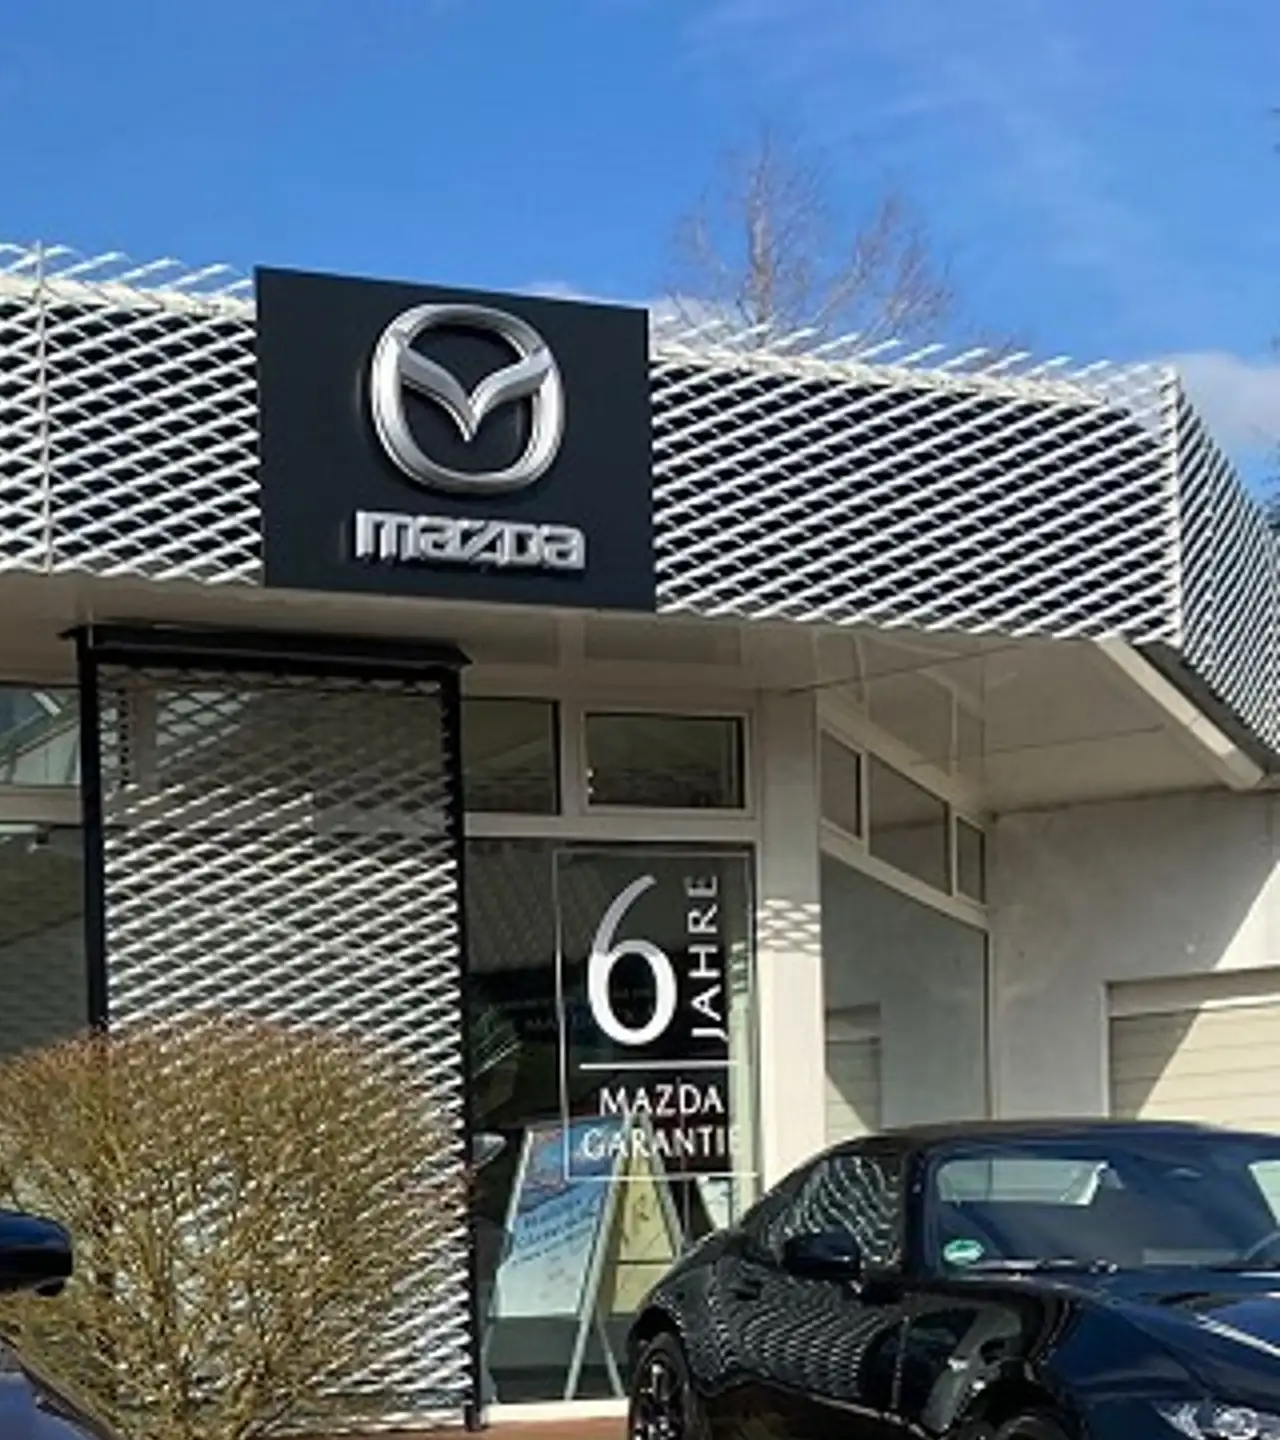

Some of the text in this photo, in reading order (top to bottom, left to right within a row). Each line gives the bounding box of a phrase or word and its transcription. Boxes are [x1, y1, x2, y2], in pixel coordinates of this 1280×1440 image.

[355, 510, 586, 571] mazda
[587, 874, 677, 1047] 6
[685, 875, 729, 1043] JAHRE
[600, 1084, 725, 1117] MAZDA
